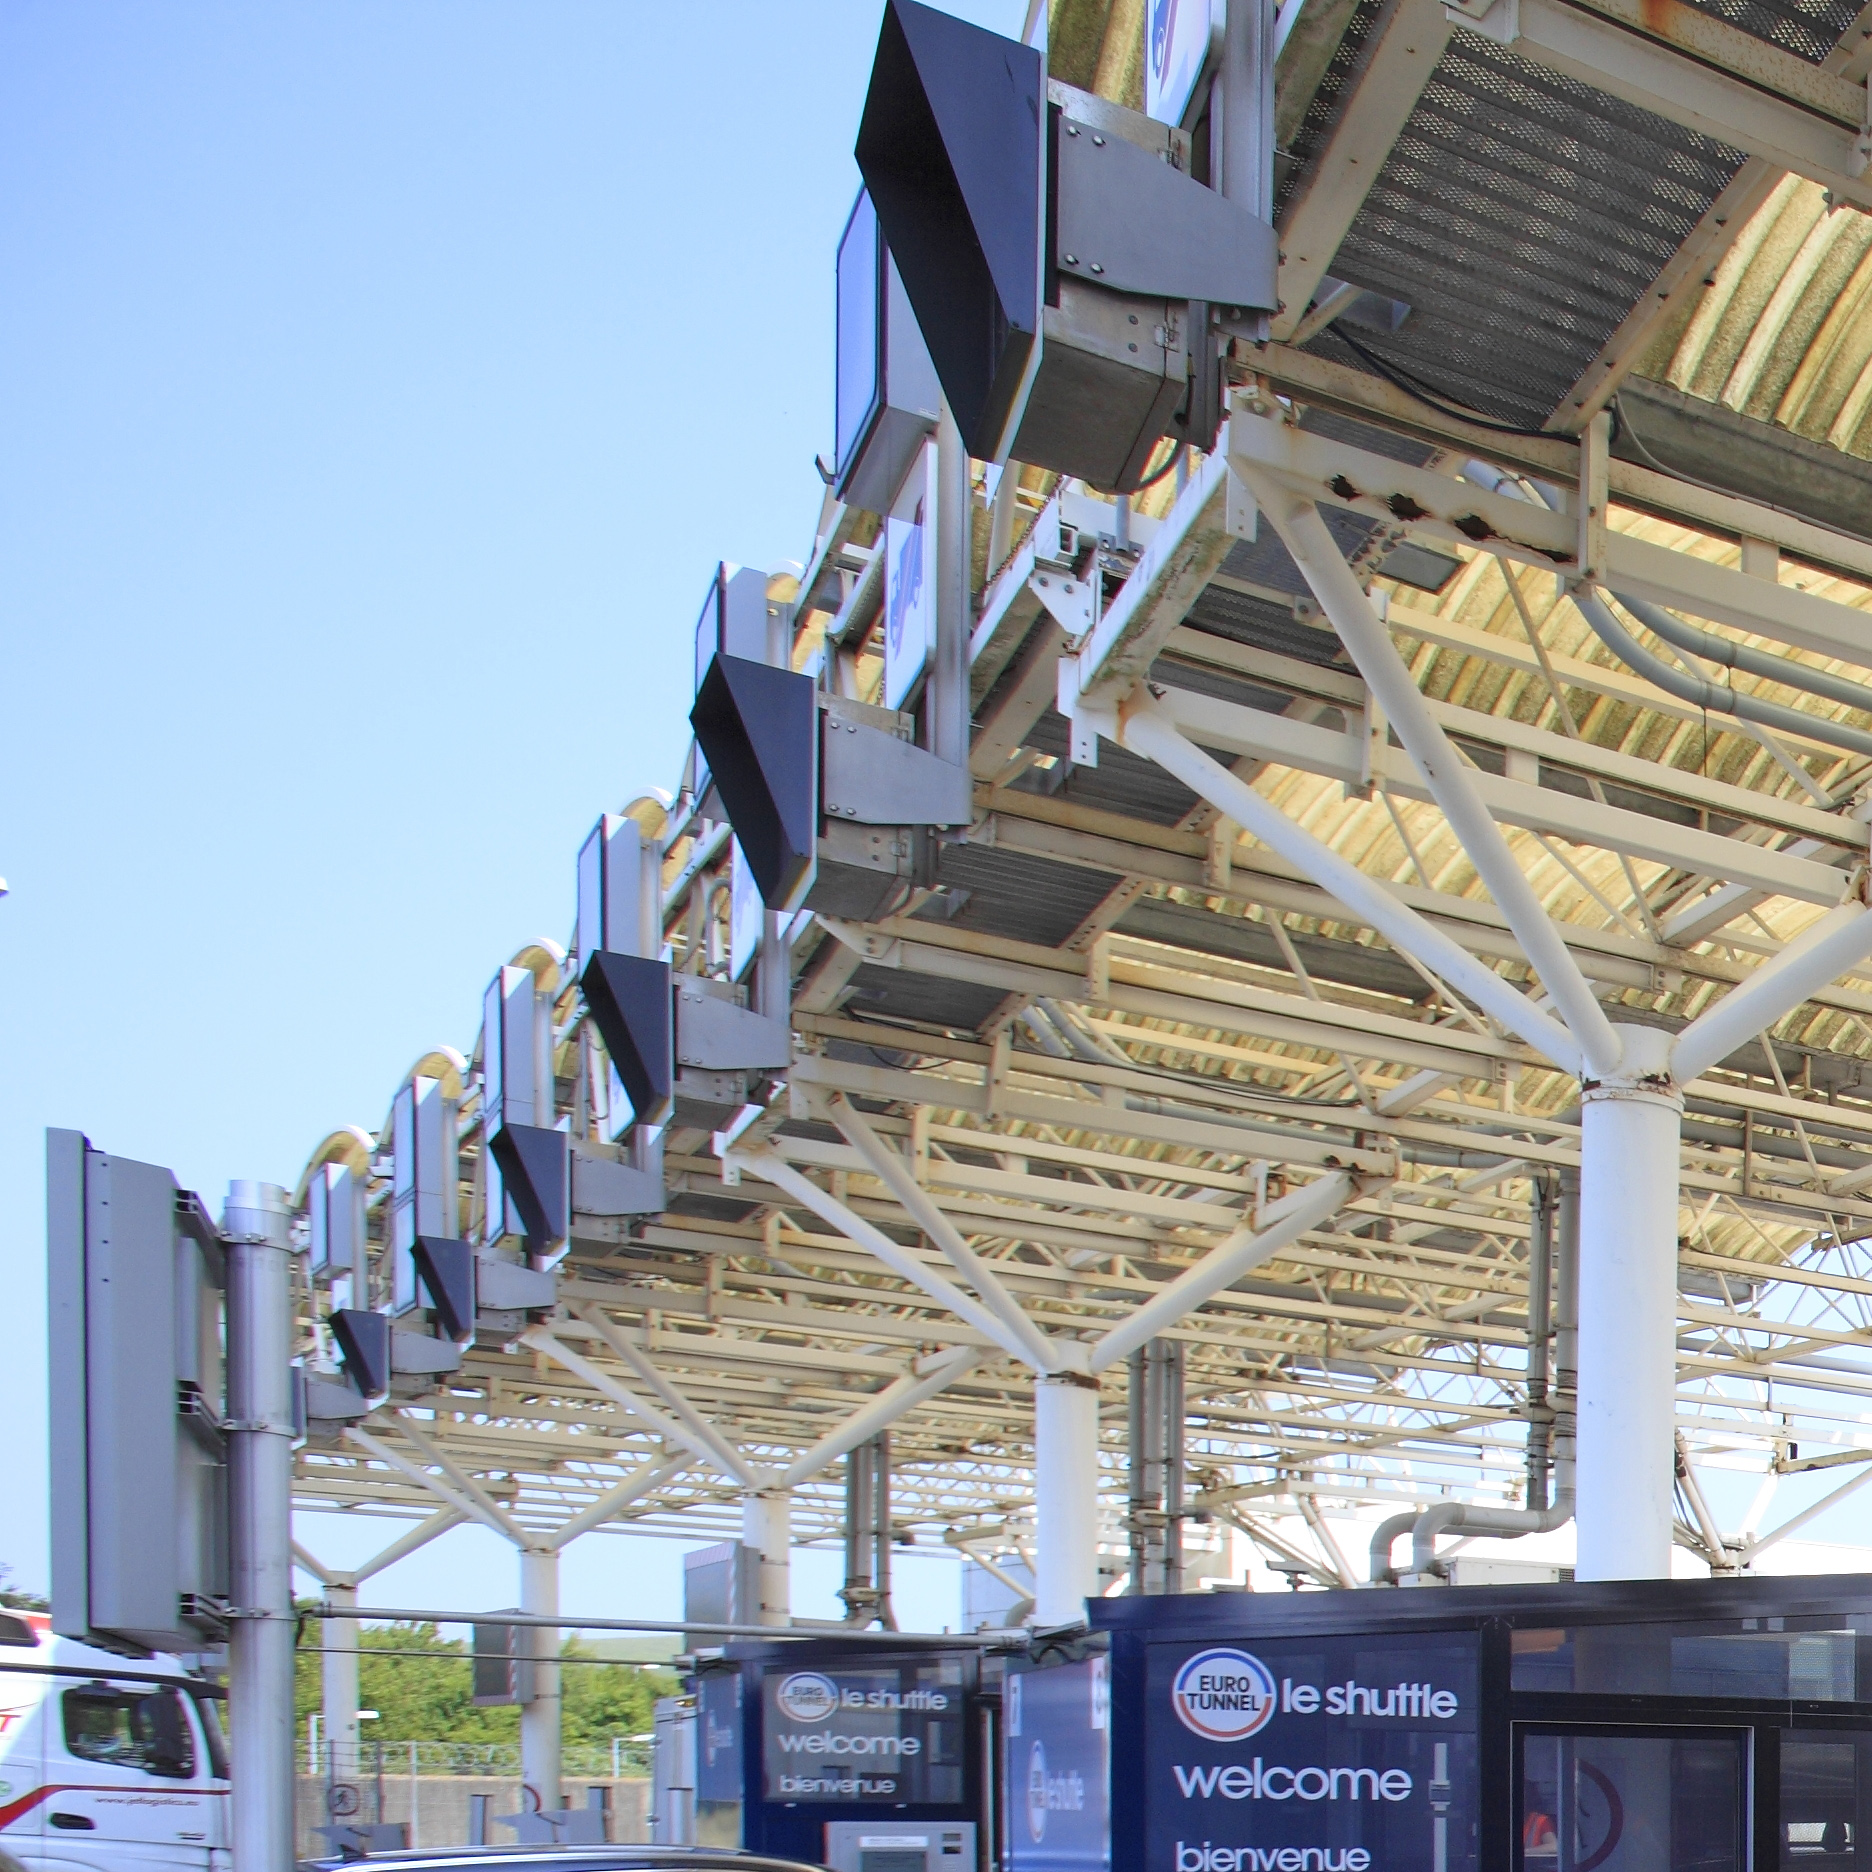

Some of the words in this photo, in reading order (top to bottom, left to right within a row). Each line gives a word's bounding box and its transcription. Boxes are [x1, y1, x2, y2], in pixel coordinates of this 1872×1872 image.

[1199, 1675, 1250, 1694] EURO
[841, 1687, 865, 1708] le
[867, 1688, 948, 1711] shuttle
[1185, 1692, 1261, 1712] TUNNEL
[1282, 1678, 1320, 1714] le
[1326, 1680, 1458, 1718] shuttle
[778, 1730, 921, 1756] welcome
[779, 1774, 896, 1794] bienvenue
[1173, 1757, 1412, 1801] welcome
[1175, 1841, 1371, 1872] bienvenue
